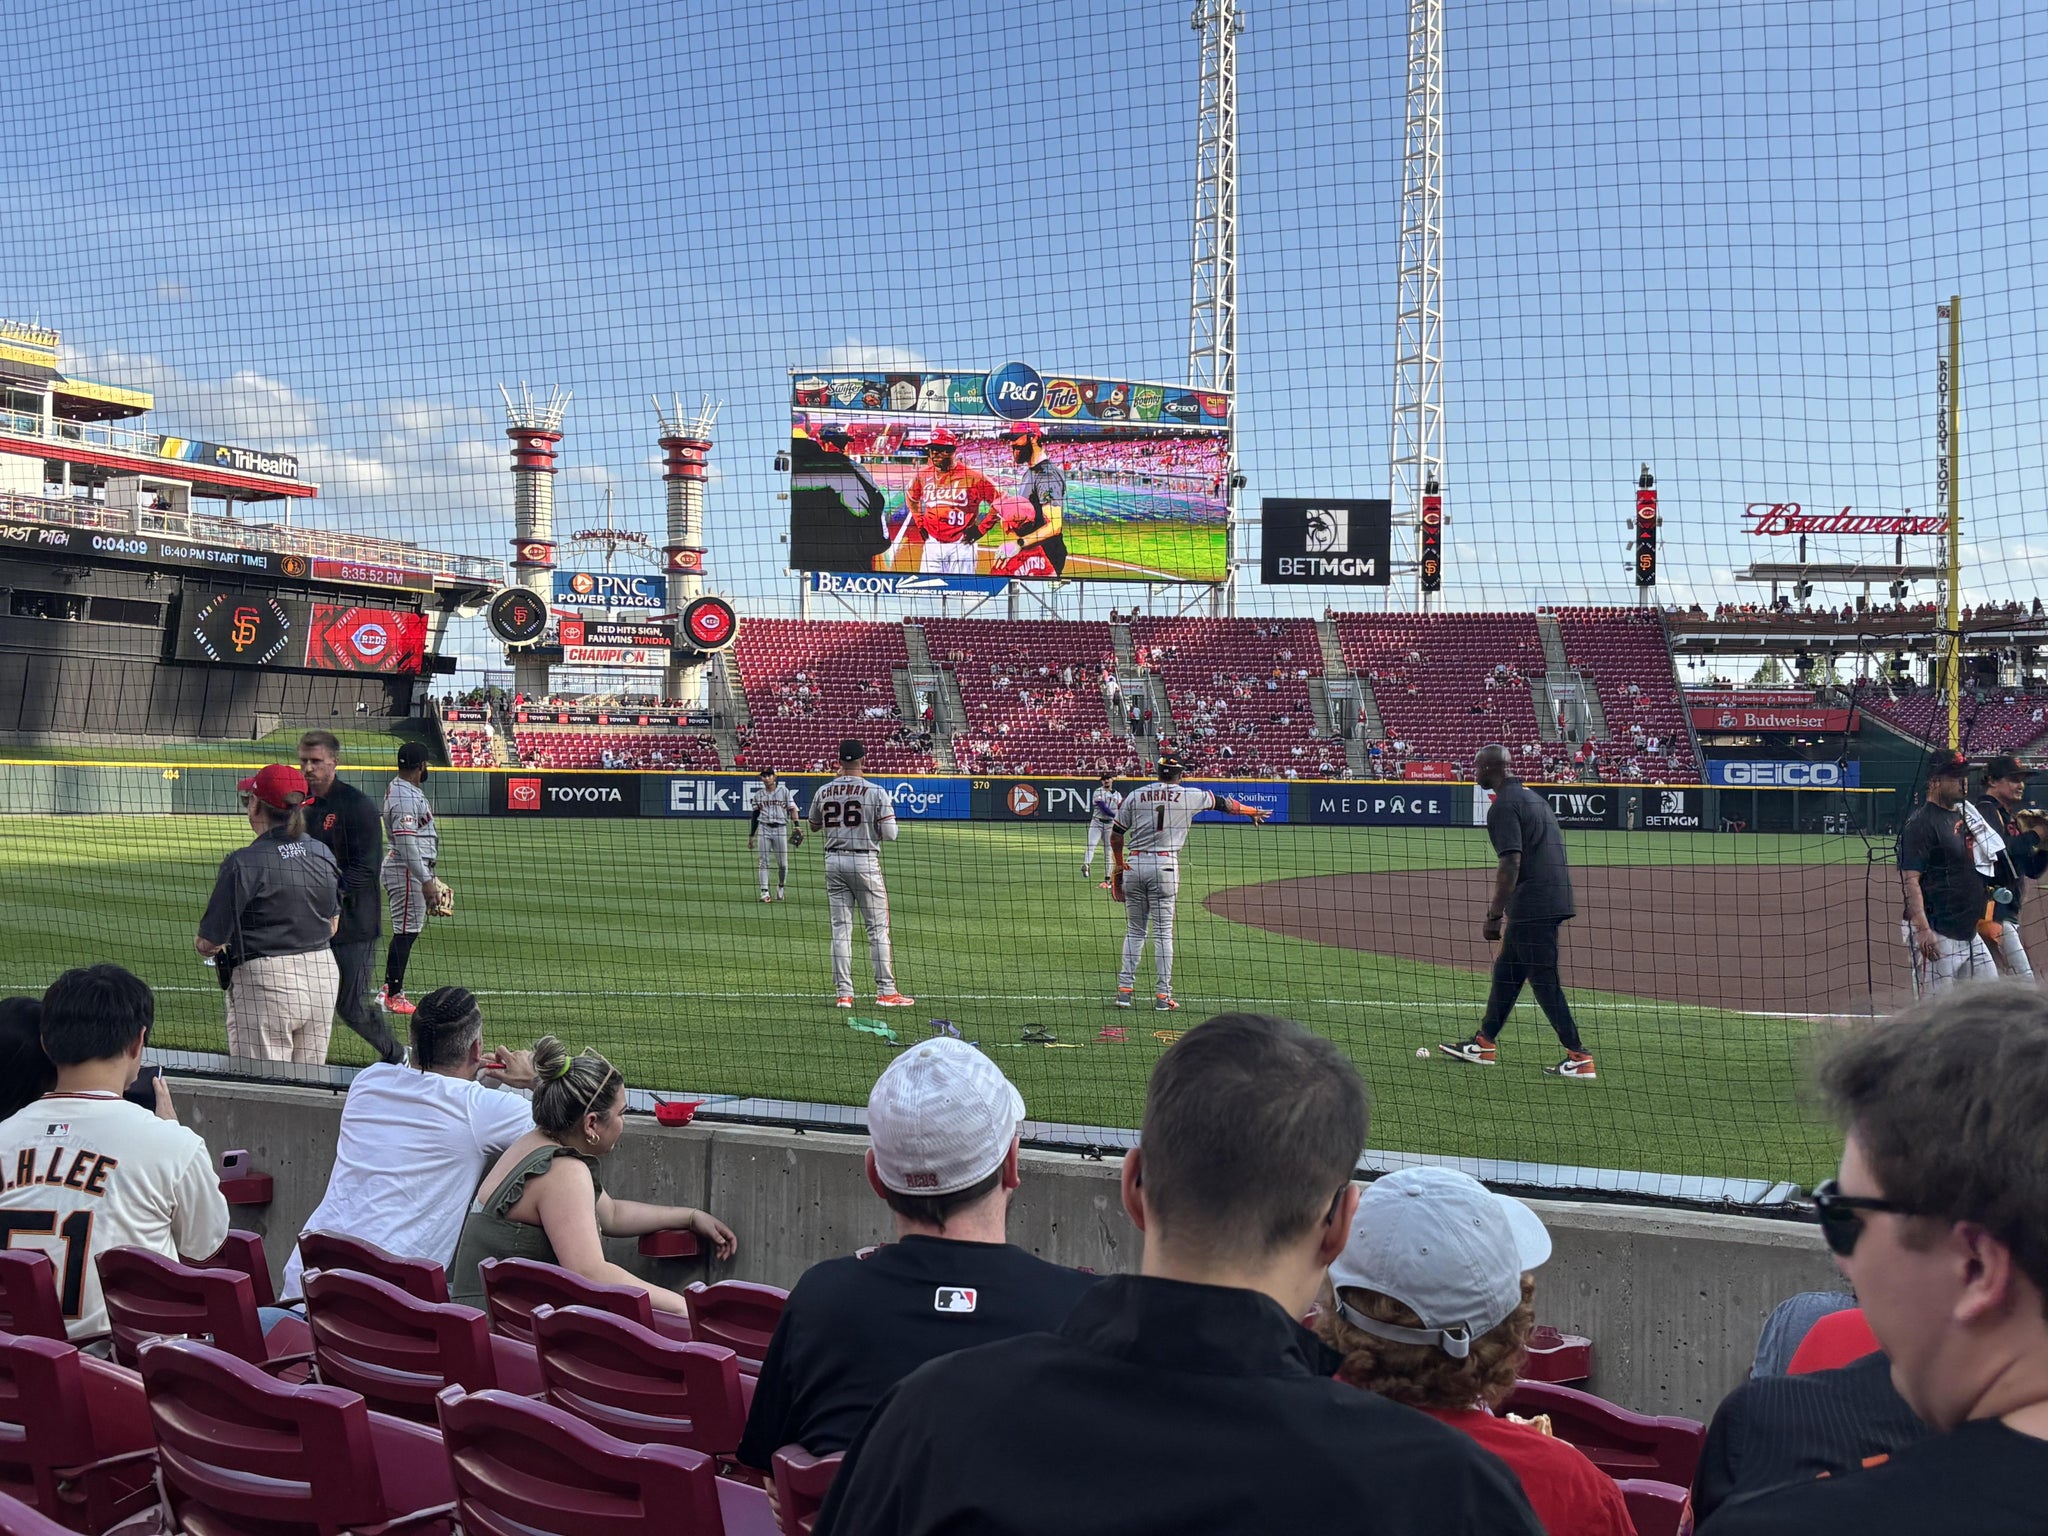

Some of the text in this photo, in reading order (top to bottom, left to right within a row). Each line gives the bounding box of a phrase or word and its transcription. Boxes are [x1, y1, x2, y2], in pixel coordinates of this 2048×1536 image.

[999, 381, 1038, 401] P&G
[1046, 386, 1078, 410] Tide
[232, 449, 297, 477] TriHealth
[923, 481, 968, 501] Reds
[948, 510, 965, 526] 99
[1746, 503, 1950, 536] Budweiser
[38, 530, 70, 547] PITCH
[92, 536, 148, 555] 0:04:09
[161, 544, 187, 558] [6:40
[189, 549, 205, 560] PM
[207, 551, 240, 564] START
[241, 555, 268, 569] TIME]
[341, 566, 404, 584] 6:35:52 PM
[1278, 557, 1376, 577] BETMGM
[596, 575, 648, 596] PNC
[558, 593, 661, 607] POWER STACKS
[361, 635, 387, 646] REDS
[588, 634, 671, 646] FAN WINS TUNDRA
[596, 625, 663, 637] RED HITS SIGN,
[1744, 713, 1825, 728] Budweiser
[162, 769, 180, 780] 404
[1723, 762, 1839, 785] GEICO
[547, 787, 622, 802] TOYOTA
[821, 784, 869, 800] CHAPMAN
[972, 781, 990, 790] 370
[888, 782, 944, 814] Kroger
[1044, 787, 1090, 813] PN
[1140, 791, 1182, 803] ARRAEZ
[1238, 792, 1278, 802] Southern
[1547, 794, 1606, 815] TWC
[823, 800, 863, 828] 26
[1155, 804, 1165, 832] 1
[1646, 815, 1699, 827] BETMGM
[278, 841, 305, 853] PUBLIC
[0, 1146, 119, 1197] .H.LEE
